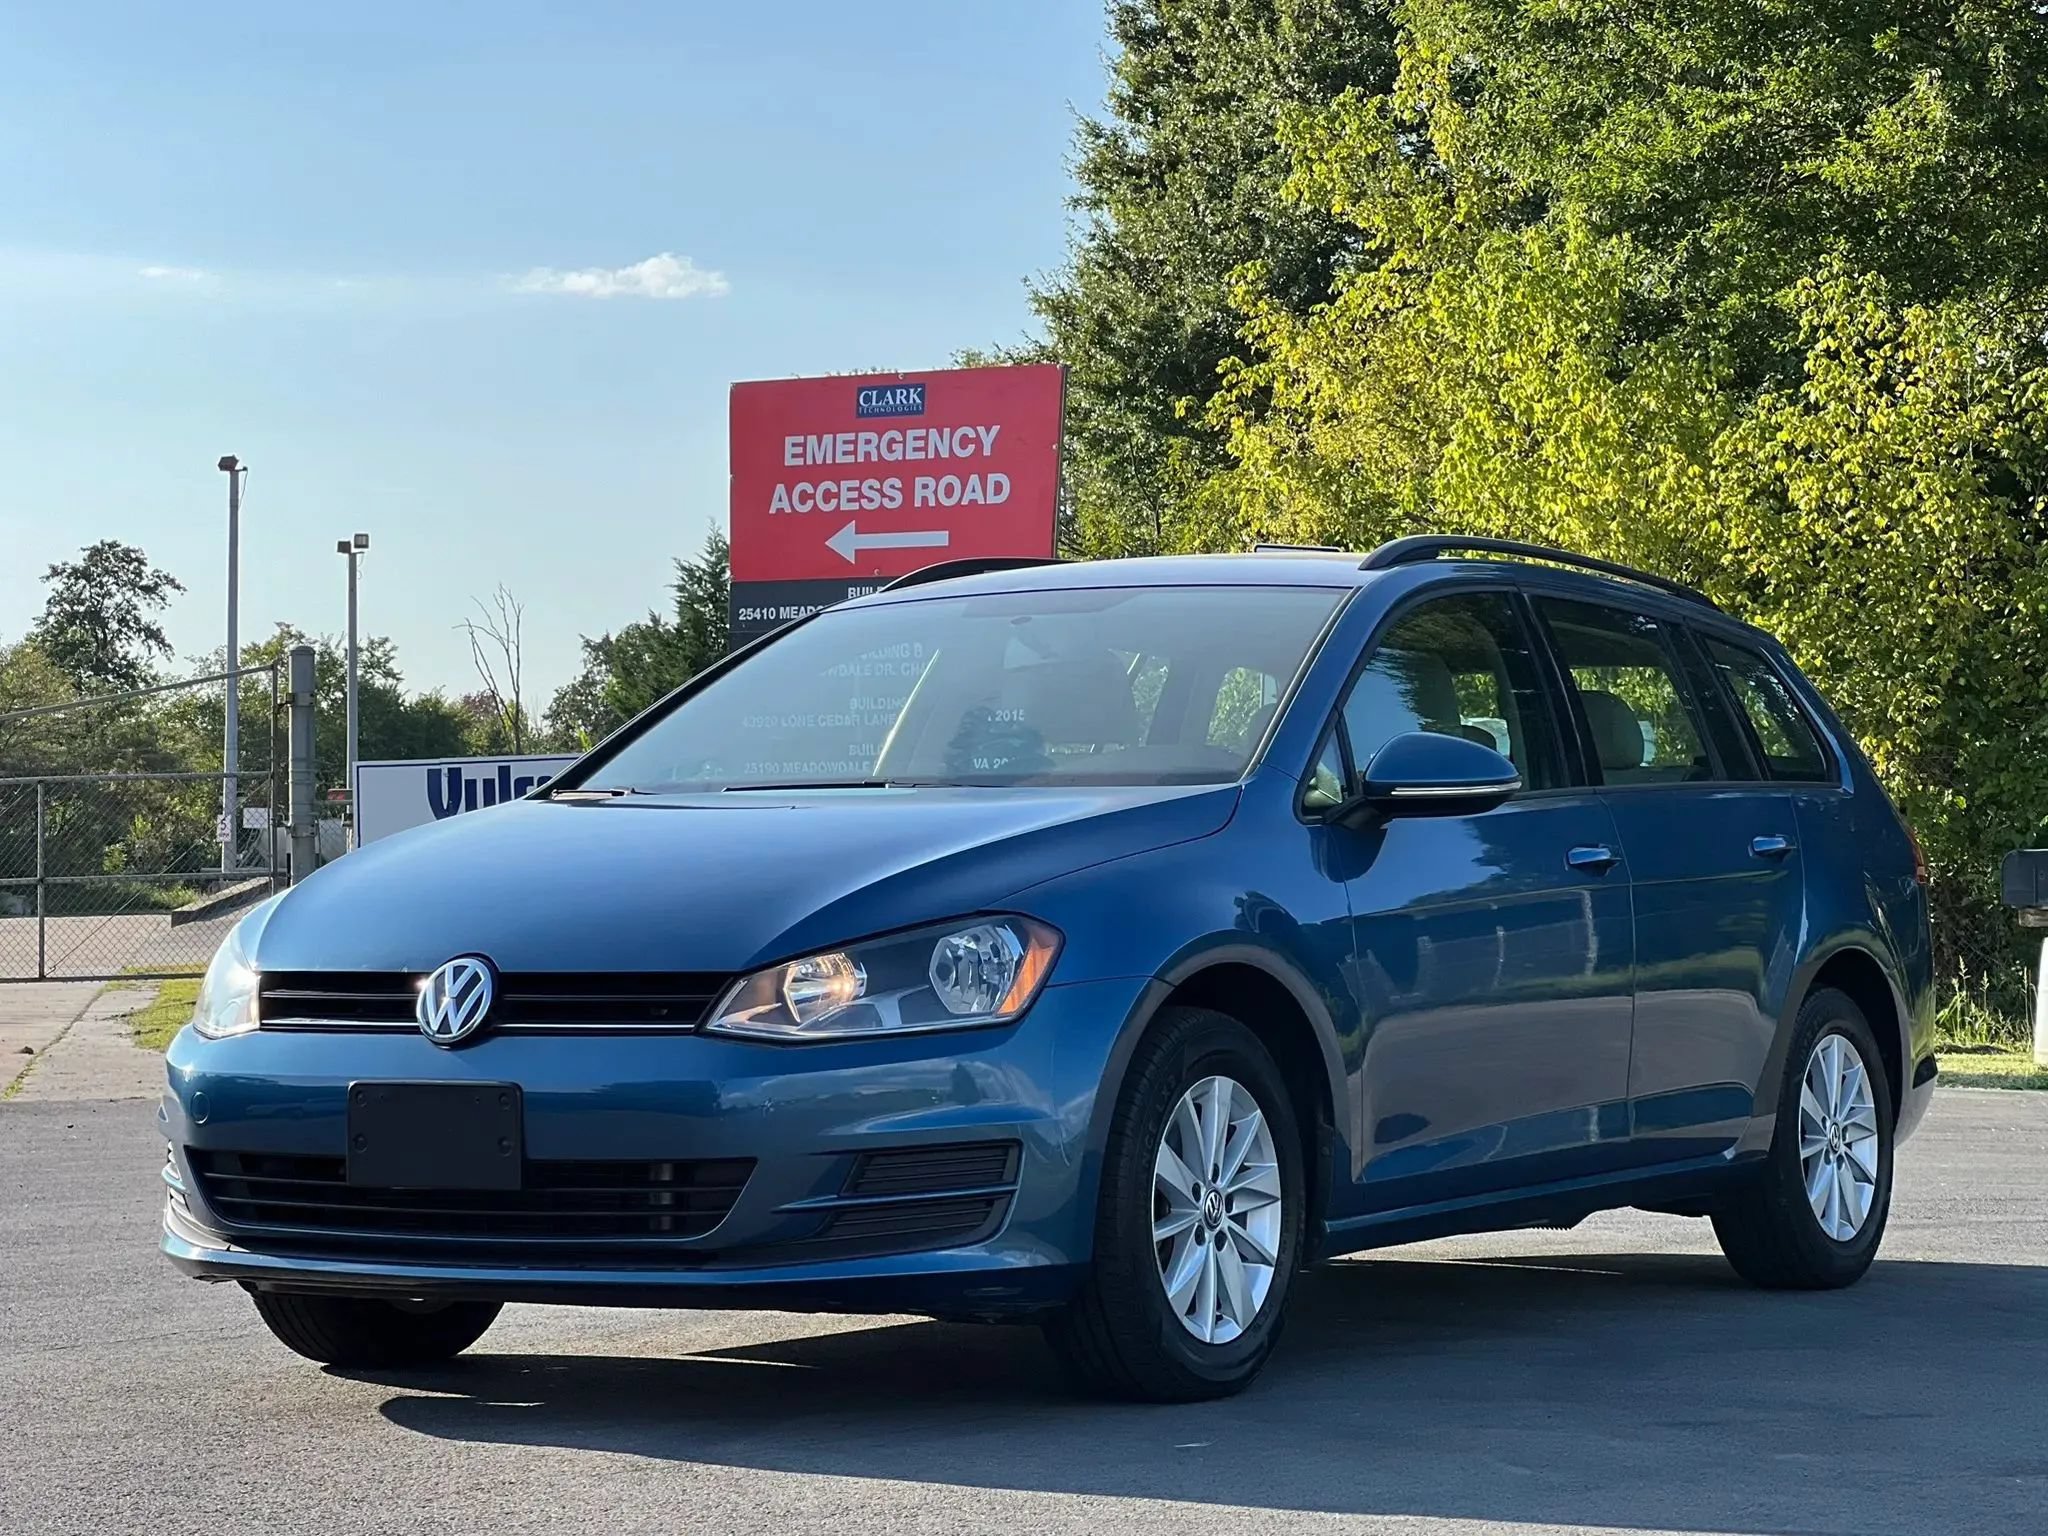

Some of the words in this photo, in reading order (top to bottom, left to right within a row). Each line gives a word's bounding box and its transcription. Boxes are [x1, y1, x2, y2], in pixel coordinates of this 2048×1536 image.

[859, 387, 922, 407] CLARK
[859, 405, 922, 415] TECHNOLOGIES
[784, 425, 1001, 467] EMERGENCY
[769, 477, 903, 514] ACCESS
[914, 473, 1011, 508] ROAD
[738, 607, 776, 621] 25410
[781, 714, 816, 727] LONE
[817, 714, 860, 727] CEDAR
[974, 758, 989, 769] VA
[418, 959, 491, 1041] VW
